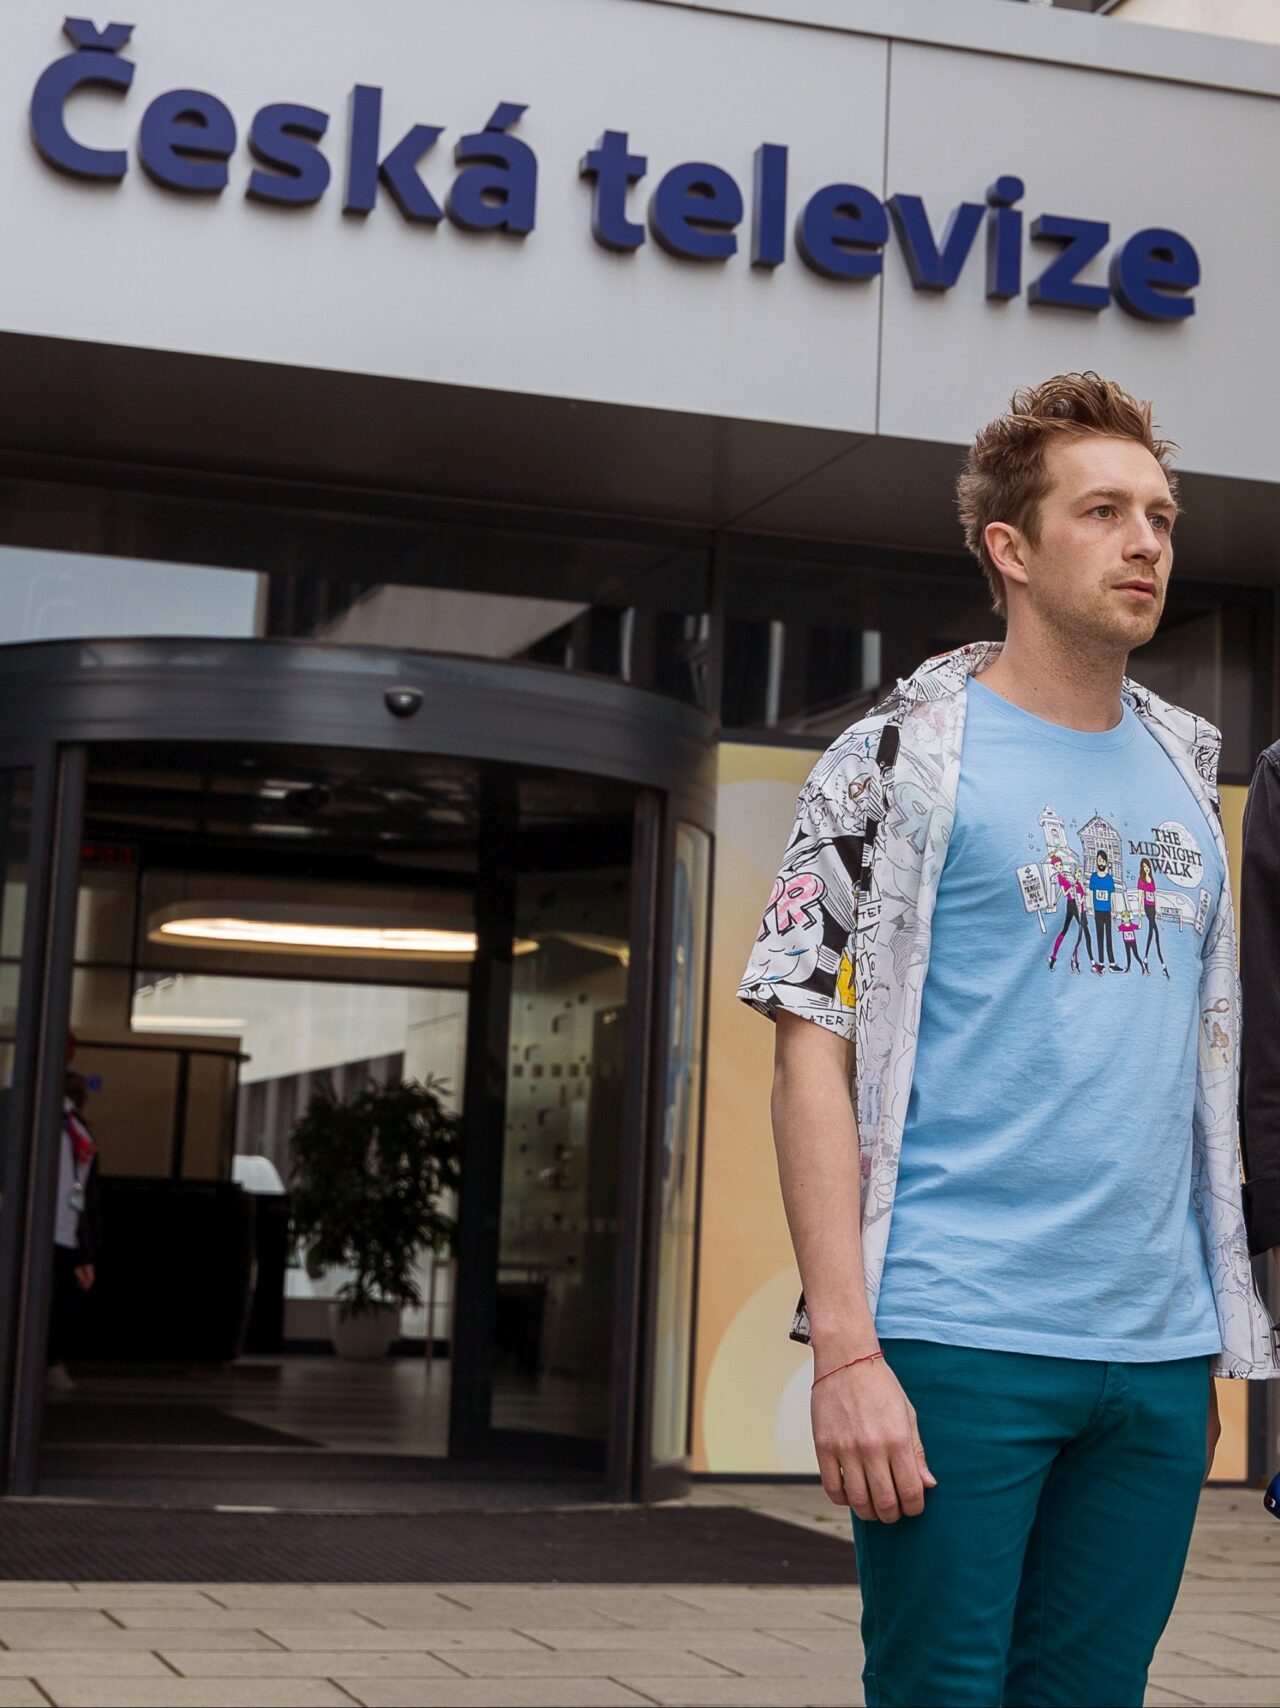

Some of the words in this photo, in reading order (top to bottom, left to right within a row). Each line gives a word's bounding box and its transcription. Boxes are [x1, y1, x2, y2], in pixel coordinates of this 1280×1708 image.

[29, 17, 540, 235] Česká
[579, 129, 1201, 322] televize
[1151, 828, 1181, 846] THE
[1128, 840, 1203, 867] MIDNIGHT
[1149, 858, 1193, 879] WALK
